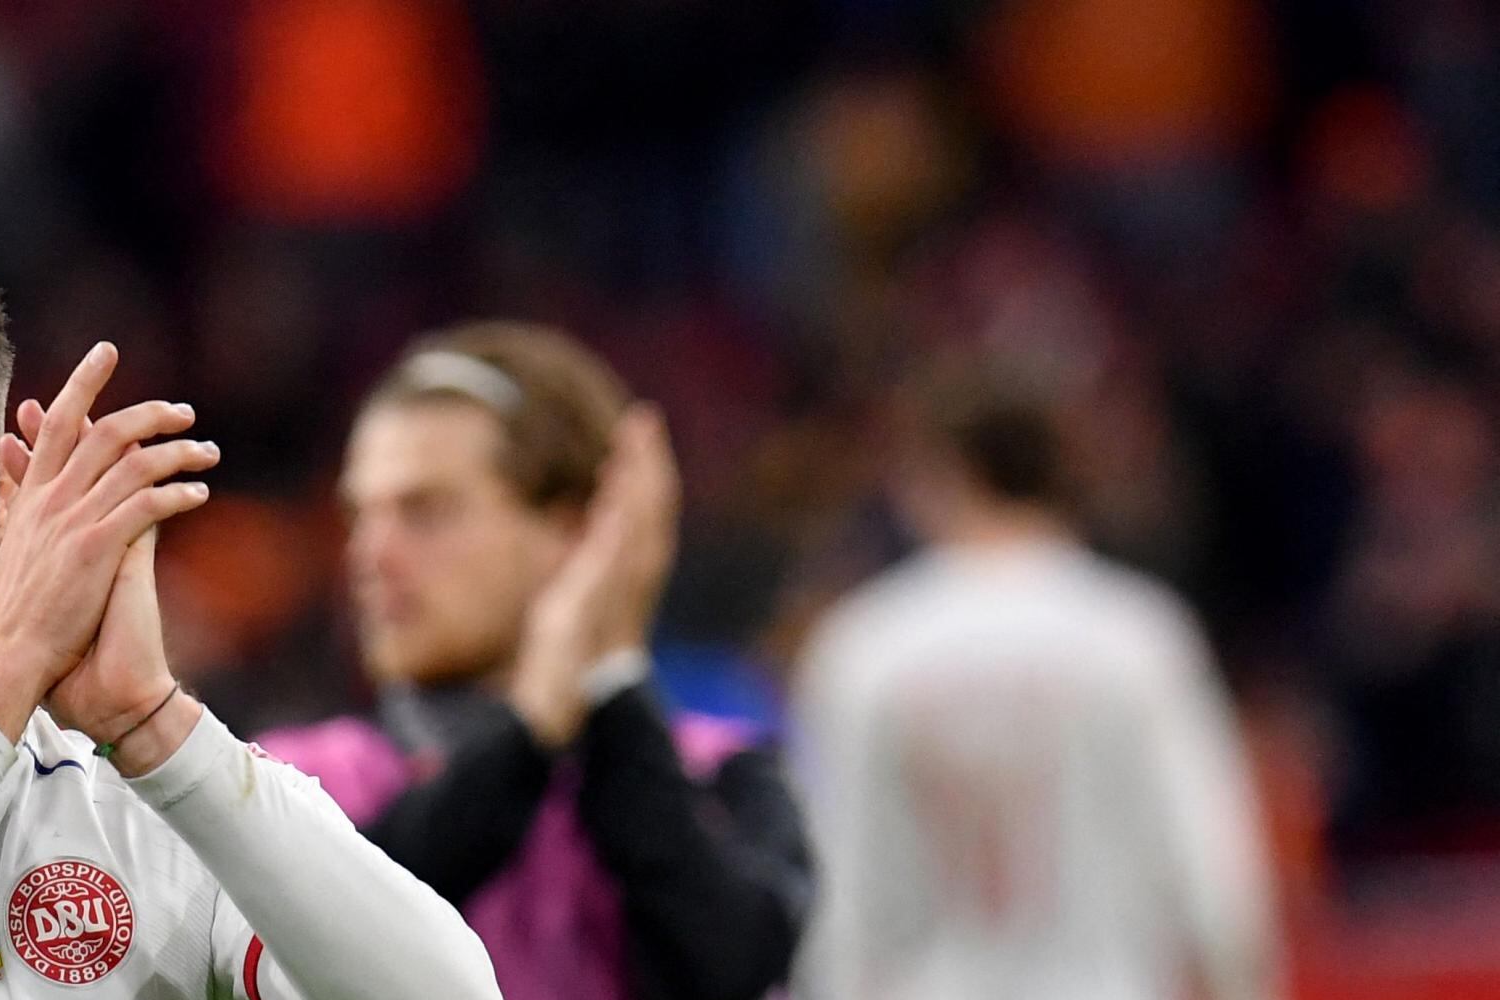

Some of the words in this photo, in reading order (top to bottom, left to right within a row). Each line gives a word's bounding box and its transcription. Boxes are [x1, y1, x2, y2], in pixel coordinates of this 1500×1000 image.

[10, 904, 51, 974] DANSK
[109, 889, 131, 959] UNION
[30, 897, 110, 943] DBU
[58, 960, 109, 983] 1889
